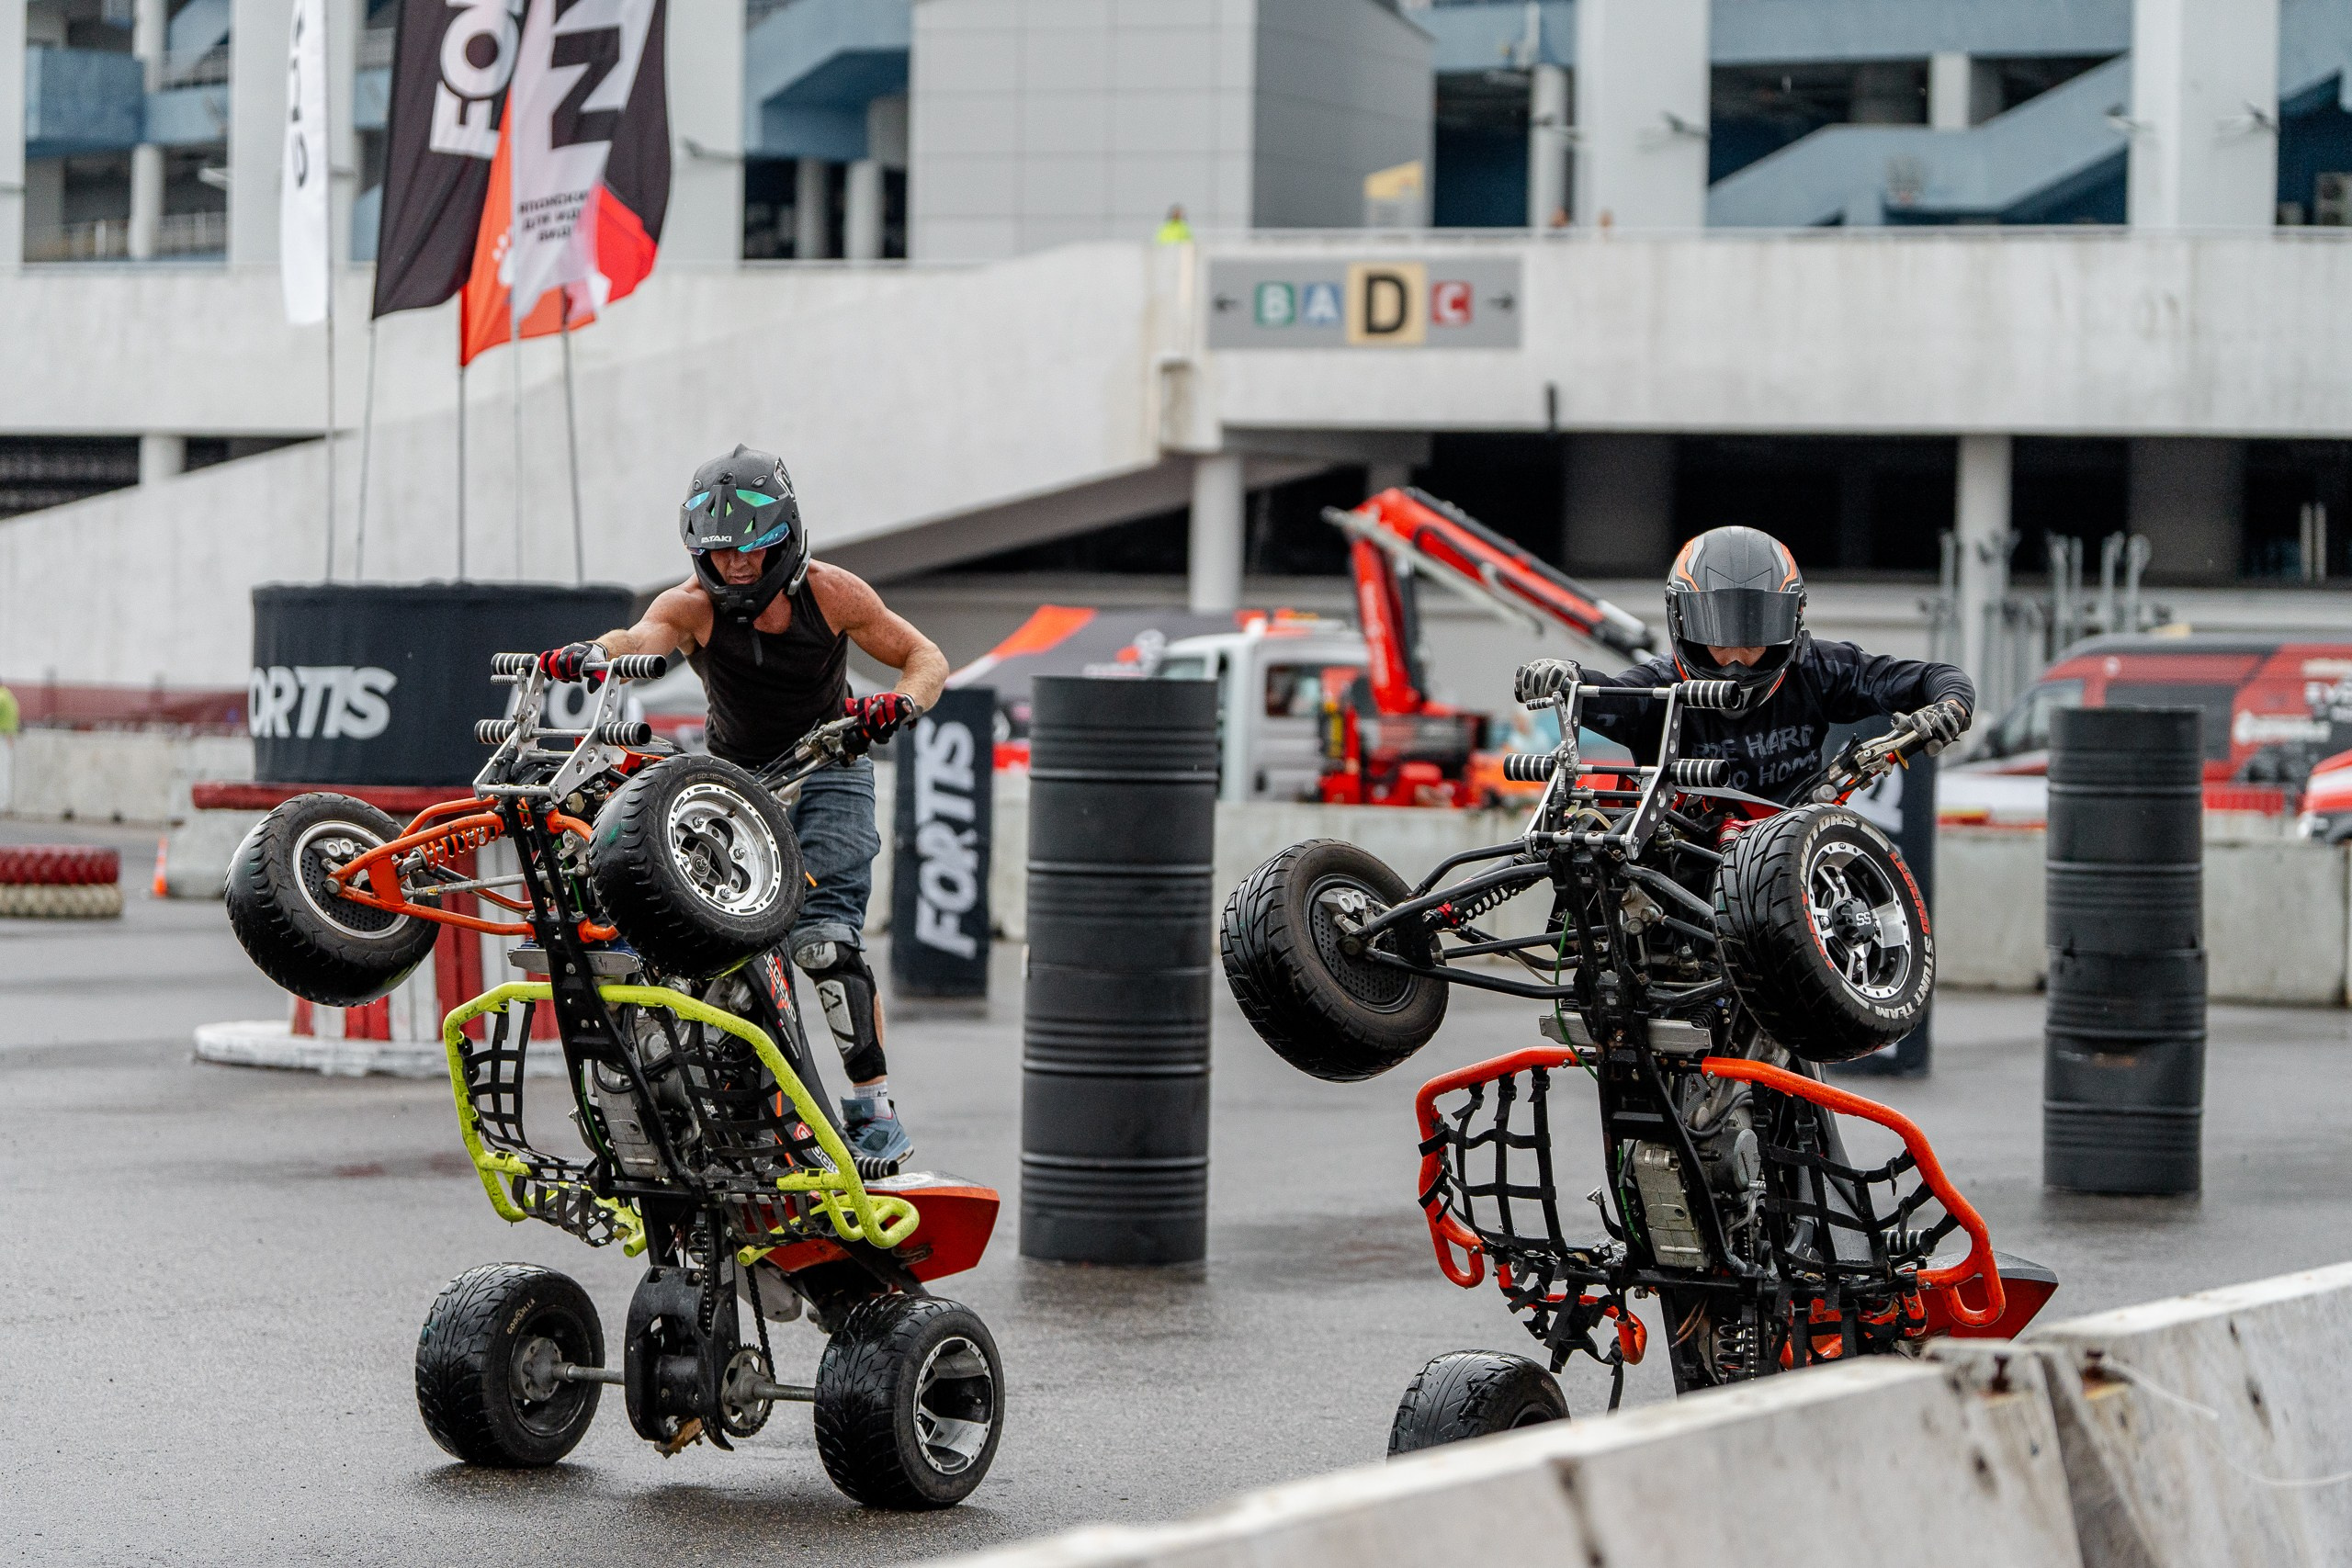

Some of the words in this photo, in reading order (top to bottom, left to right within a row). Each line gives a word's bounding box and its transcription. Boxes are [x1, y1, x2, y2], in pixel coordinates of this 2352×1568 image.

[1261, 283, 1294, 325] B
[1305, 284, 1340, 324] A
[1363, 272, 1409, 336] D
[1435, 283, 1468, 323] C
[701, 535, 732, 543] ATAKI
[1745, 724, 1815, 759] HARD
[914, 715, 978, 961] FORTIS
[1889, 851, 1931, 935] LEGEND
[1856, 911, 1871, 927] SS
[1914, 935, 1935, 1008] STUNT
[1874, 1001, 1917, 1020] TEAM
